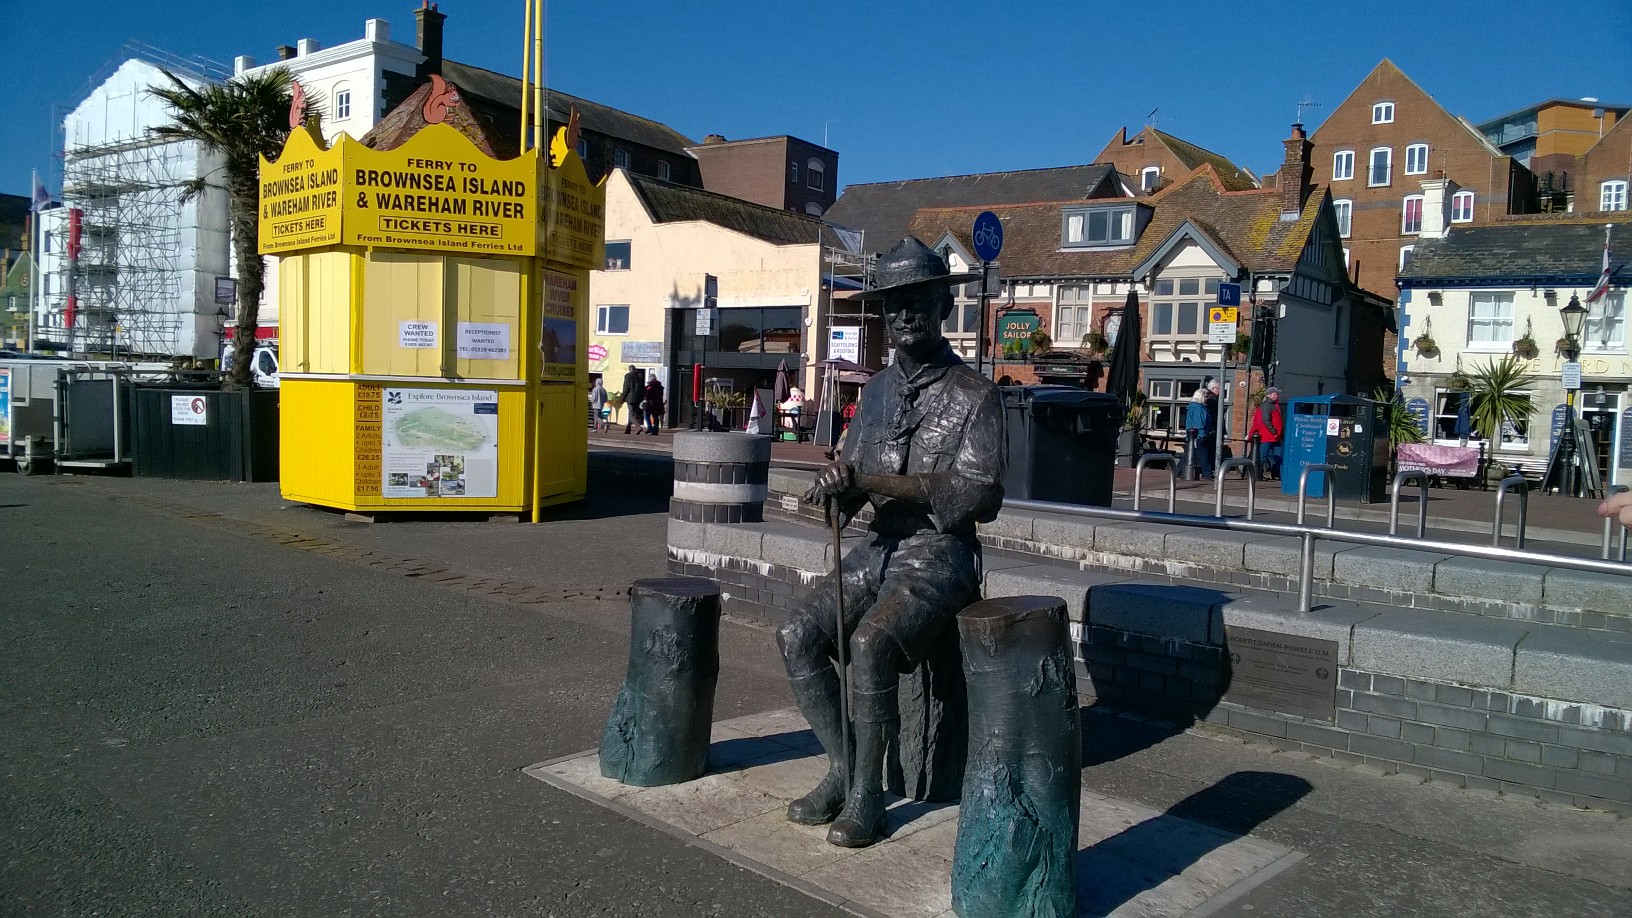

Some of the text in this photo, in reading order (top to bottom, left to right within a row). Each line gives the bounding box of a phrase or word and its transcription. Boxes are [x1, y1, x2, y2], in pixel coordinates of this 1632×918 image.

[283, 159, 314, 174] FERRY TO
[407, 158, 477, 173] FERRY TO
[263, 168, 338, 199] BROWNSEA ISLAND
[356, 169, 526, 198] BROWNSEA ISLAND
[263, 191, 337, 219] & WAREHAM RIVER
[356, 191, 524, 219] & WAREHAM RIVER
[274, 218, 324, 235] TICKETS HERE
[383, 218, 499, 236] TICKETS HERE
[263, 242, 273, 250] From
[275, 239, 295, 248] Brownsea
[297, 237, 310, 245] Island
[311, 235, 326, 243] Ferries
[357, 234, 382, 243] From
[386, 236, 435, 246] Brownsea
[438, 239, 468, 248] Island
[471, 242, 504, 250] Ferries
[1222, 289, 1230, 300] TA
[1552, 359, 1610, 373] LRD
[408, 392, 492, 402] Explore Brownsea Island
[1258, 641, 1313, 654] BADEN-POWELL
